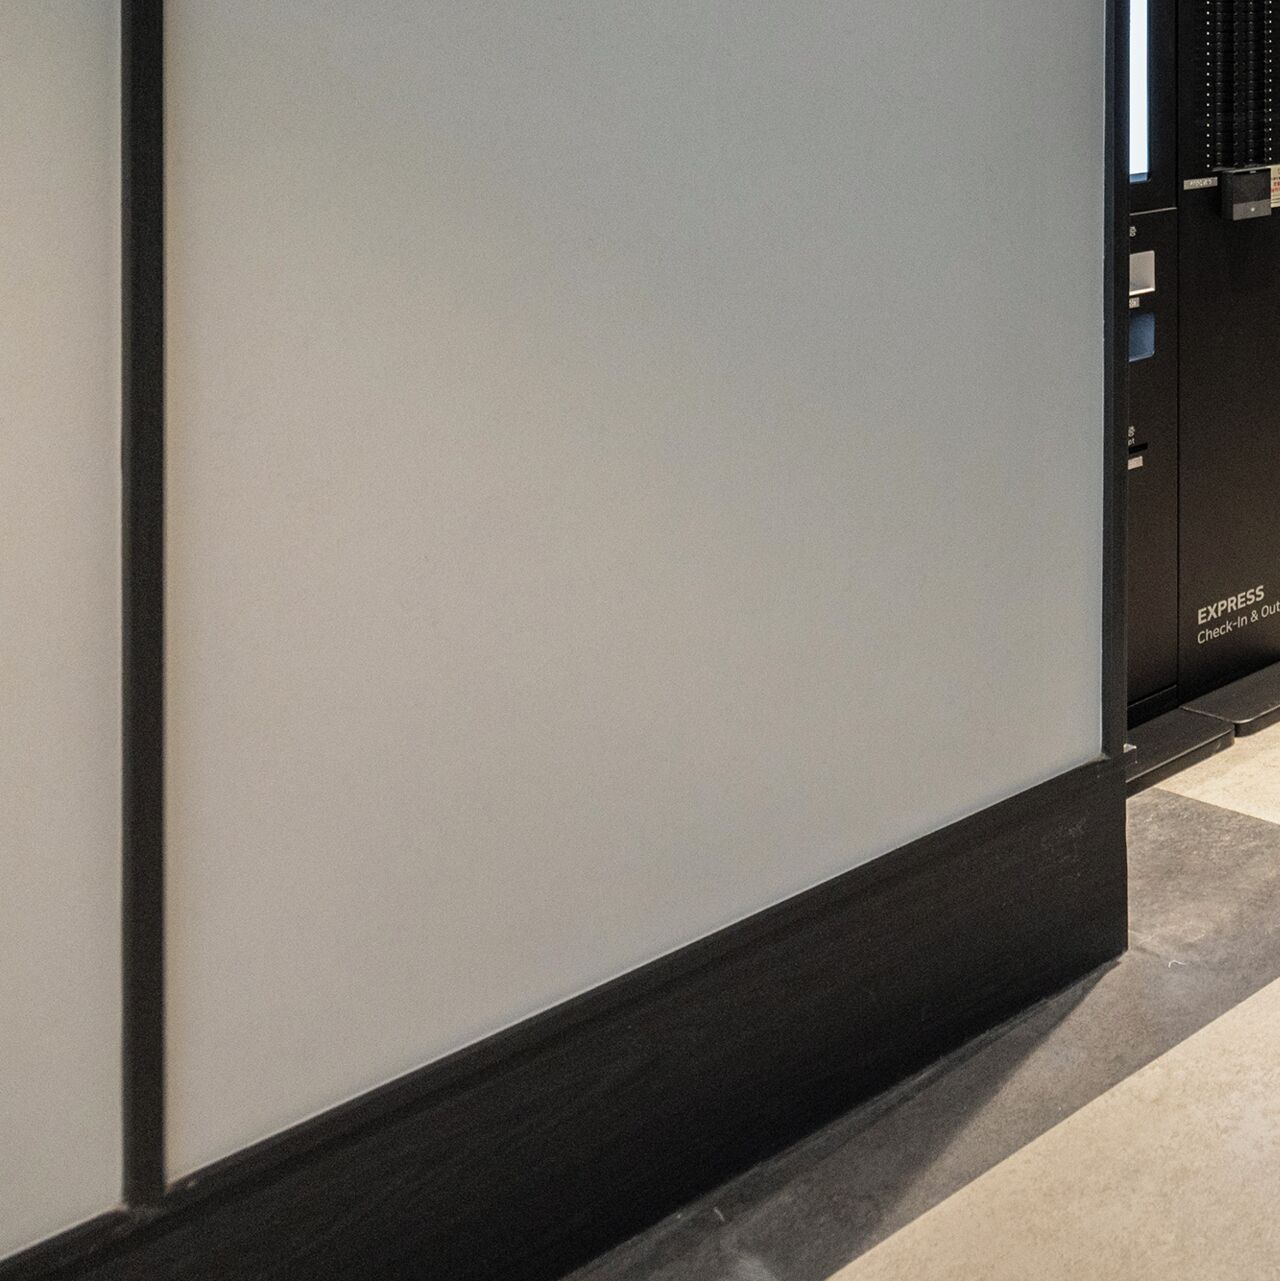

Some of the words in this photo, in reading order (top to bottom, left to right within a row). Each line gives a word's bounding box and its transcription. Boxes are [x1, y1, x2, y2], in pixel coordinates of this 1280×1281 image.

[1197, 585, 1265, 625] EXPRESS
[1197, 615, 1248, 645] Check-In
[1250, 609, 1259, 623] &
[1261, 600, 1280, 618] Out
